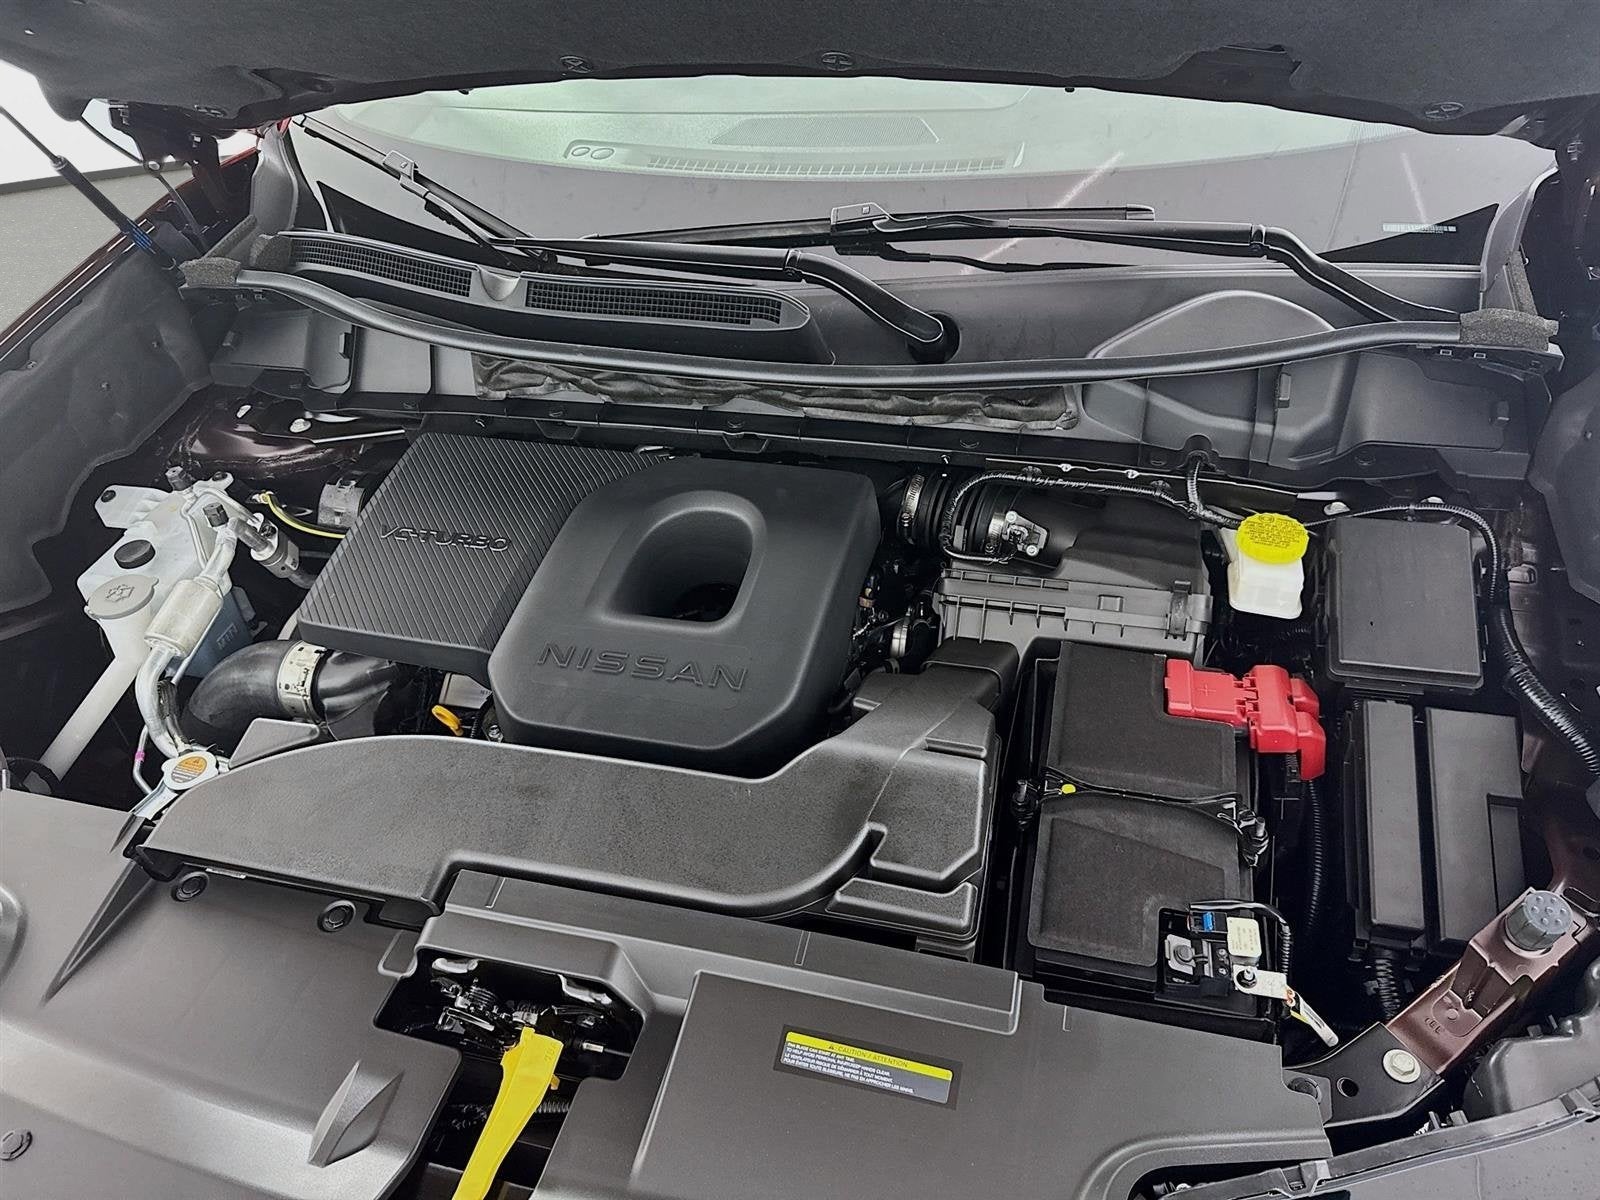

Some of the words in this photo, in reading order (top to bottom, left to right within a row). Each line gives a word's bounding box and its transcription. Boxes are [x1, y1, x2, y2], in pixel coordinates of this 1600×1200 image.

[537, 642, 748, 692] NISSAN
[837, 1045, 866, 1057] CAUTION
[872, 1054, 908, 1067] ATTENTION
